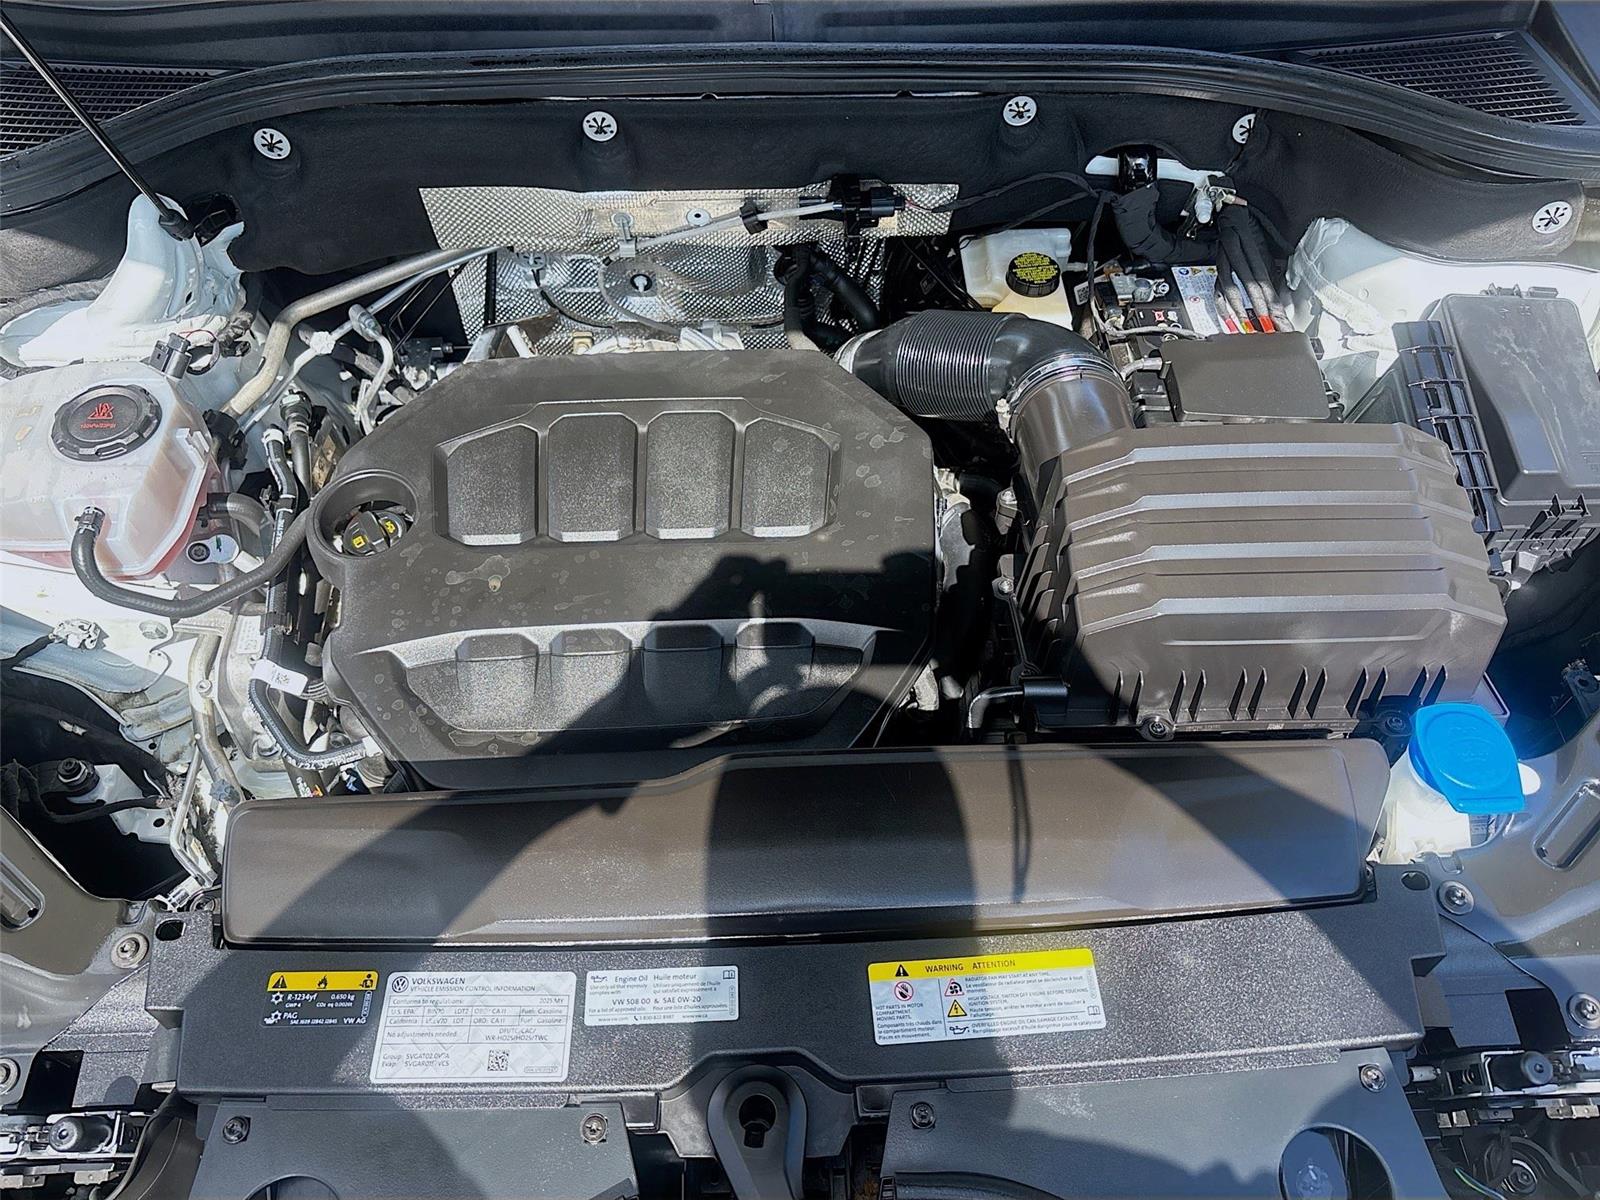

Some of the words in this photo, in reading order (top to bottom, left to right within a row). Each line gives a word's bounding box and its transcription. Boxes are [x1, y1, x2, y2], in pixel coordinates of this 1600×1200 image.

[925, 963, 964, 973] WARNING
[972, 960, 1016, 970] ATTENTION
[615, 975, 637, 984] Engine
[287, 992, 318, 1002] R-1234yf
